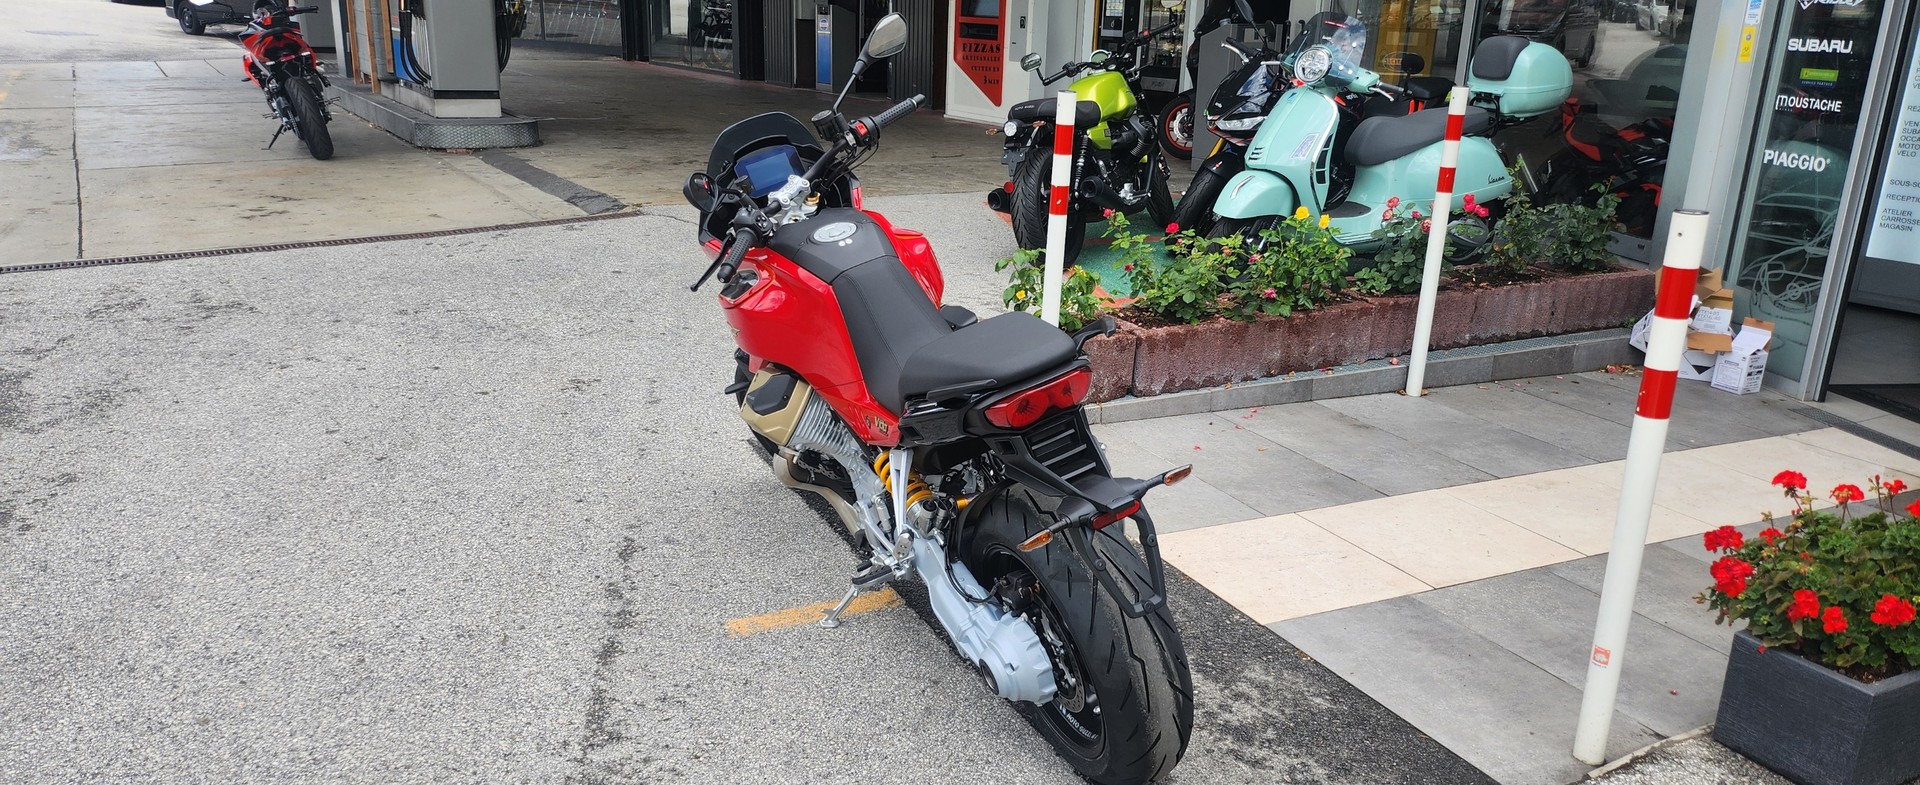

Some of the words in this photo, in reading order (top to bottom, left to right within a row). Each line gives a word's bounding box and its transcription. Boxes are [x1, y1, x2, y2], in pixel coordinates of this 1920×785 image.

[962, 43, 1001, 53] PIZZAS
[1788, 38, 1853, 54] SUBARU
[1775, 95, 1843, 112] MOUSTACHE
[1897, 149, 1916, 157] VELO
[1763, 149, 1827, 172] PIAGGIO
[1882, 207, 1913, 217] ATELIER
[1879, 221, 1913, 231] MAGASIN
[1066, 713, 1080, 728] MOTO
